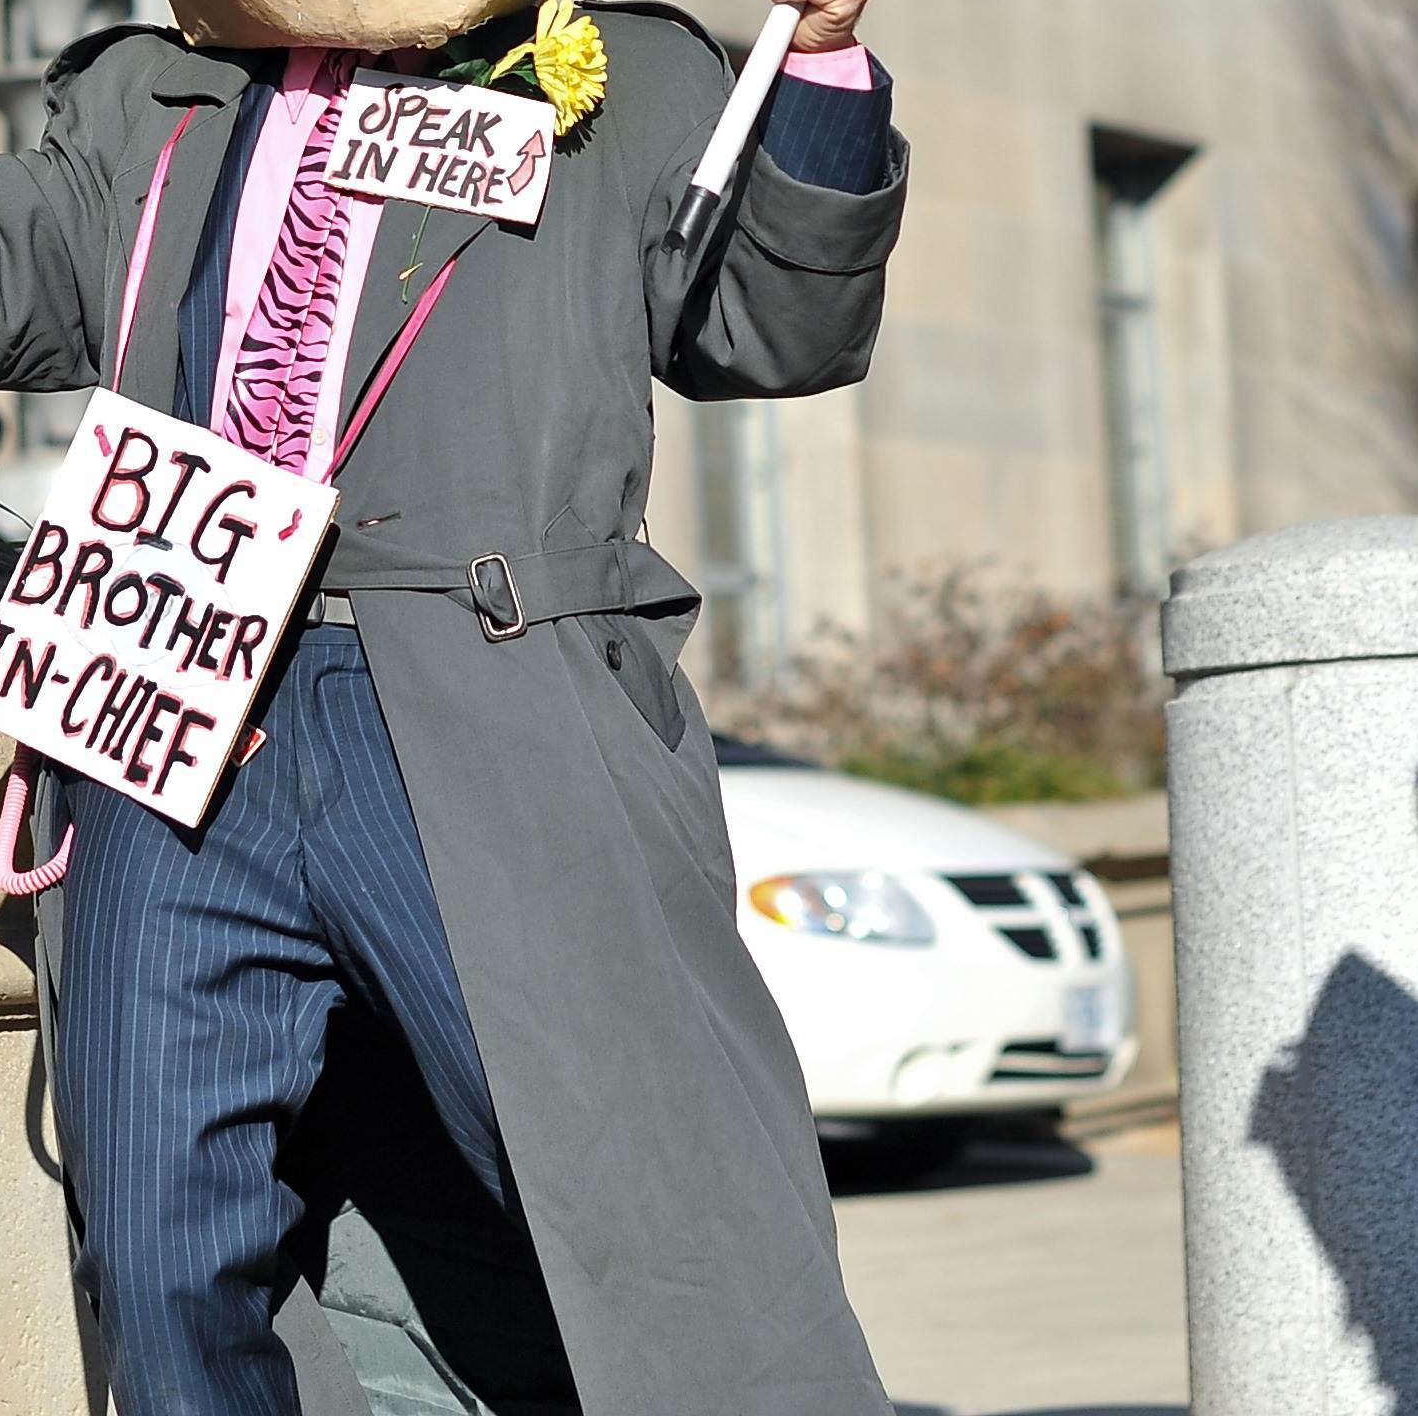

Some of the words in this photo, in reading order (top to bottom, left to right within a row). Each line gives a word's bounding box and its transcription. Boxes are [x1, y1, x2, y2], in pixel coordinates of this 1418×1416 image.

[329, 140, 399, 183] IN
[406, 151, 506, 207] HERE
[359, 83, 502, 157] SPEAK
[91, 426, 258, 583] BIG
[9, 519, 269, 683] BROTHER
